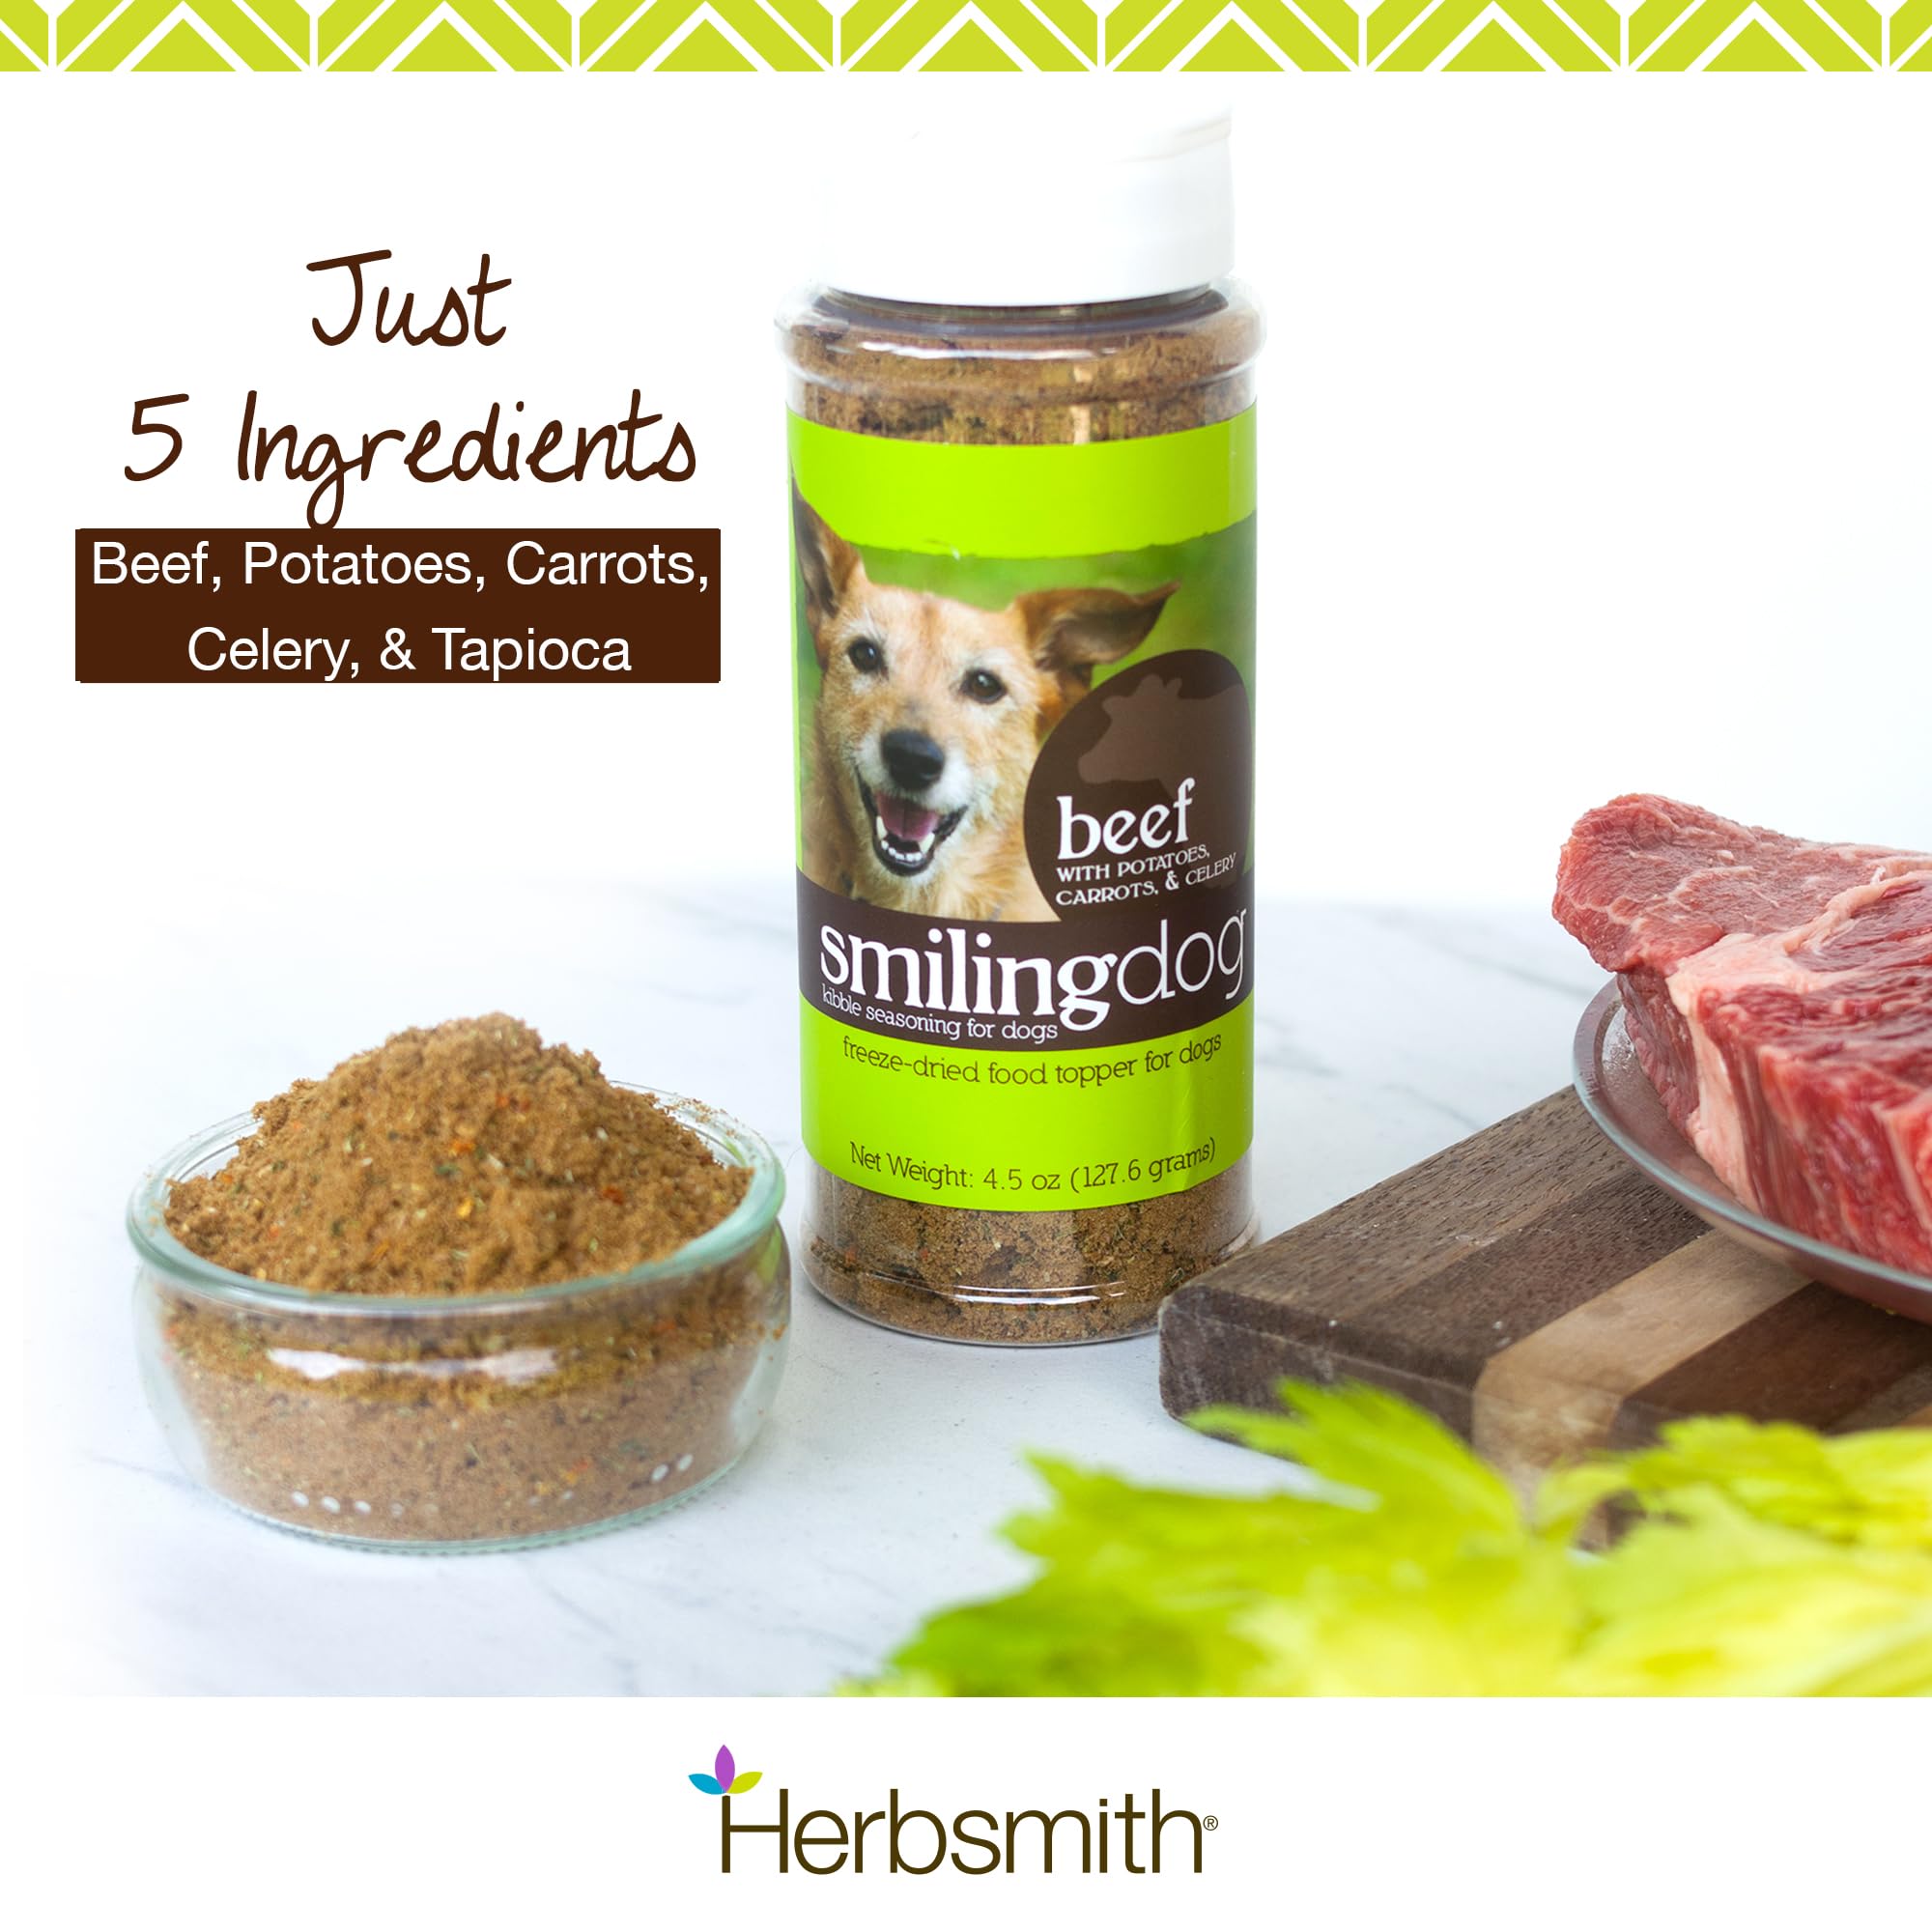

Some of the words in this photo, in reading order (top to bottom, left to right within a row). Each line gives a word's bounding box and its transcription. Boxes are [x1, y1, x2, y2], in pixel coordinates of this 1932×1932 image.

[1057, 778, 1196, 860] beef
[1056, 880, 1159, 906] CARROTS,
[1165, 870, 1180, 891] &
[1185, 852, 1237, 886] CELERY
[1057, 853, 1110, 883] WITH
[1117, 843, 1210, 878] POTATOES,
[822, 983, 862, 1017] kibble
[866, 1006, 961, 1040] seasoning
[966, 1018, 996, 1039] for
[1001, 1020, 1058, 1044] dogs
[842, 1035, 980, 1084] freeze-dried
[988, 1062, 1048, 1085] food
[1055, 1061, 1138, 1089] topper
[1144, 1048, 1173, 1071] for
[1179, 1033, 1223, 1065] dogs
[850, 1141, 883, 1172] Net
[886, 1152, 974, 1190] Weight:
[982, 1168, 1023, 1190] 4.5
[1032, 1174, 1061, 1190] oz
[1070, 1162, 1142, 1194] (127.6
[1148, 1136, 1216, 1182] grams)
